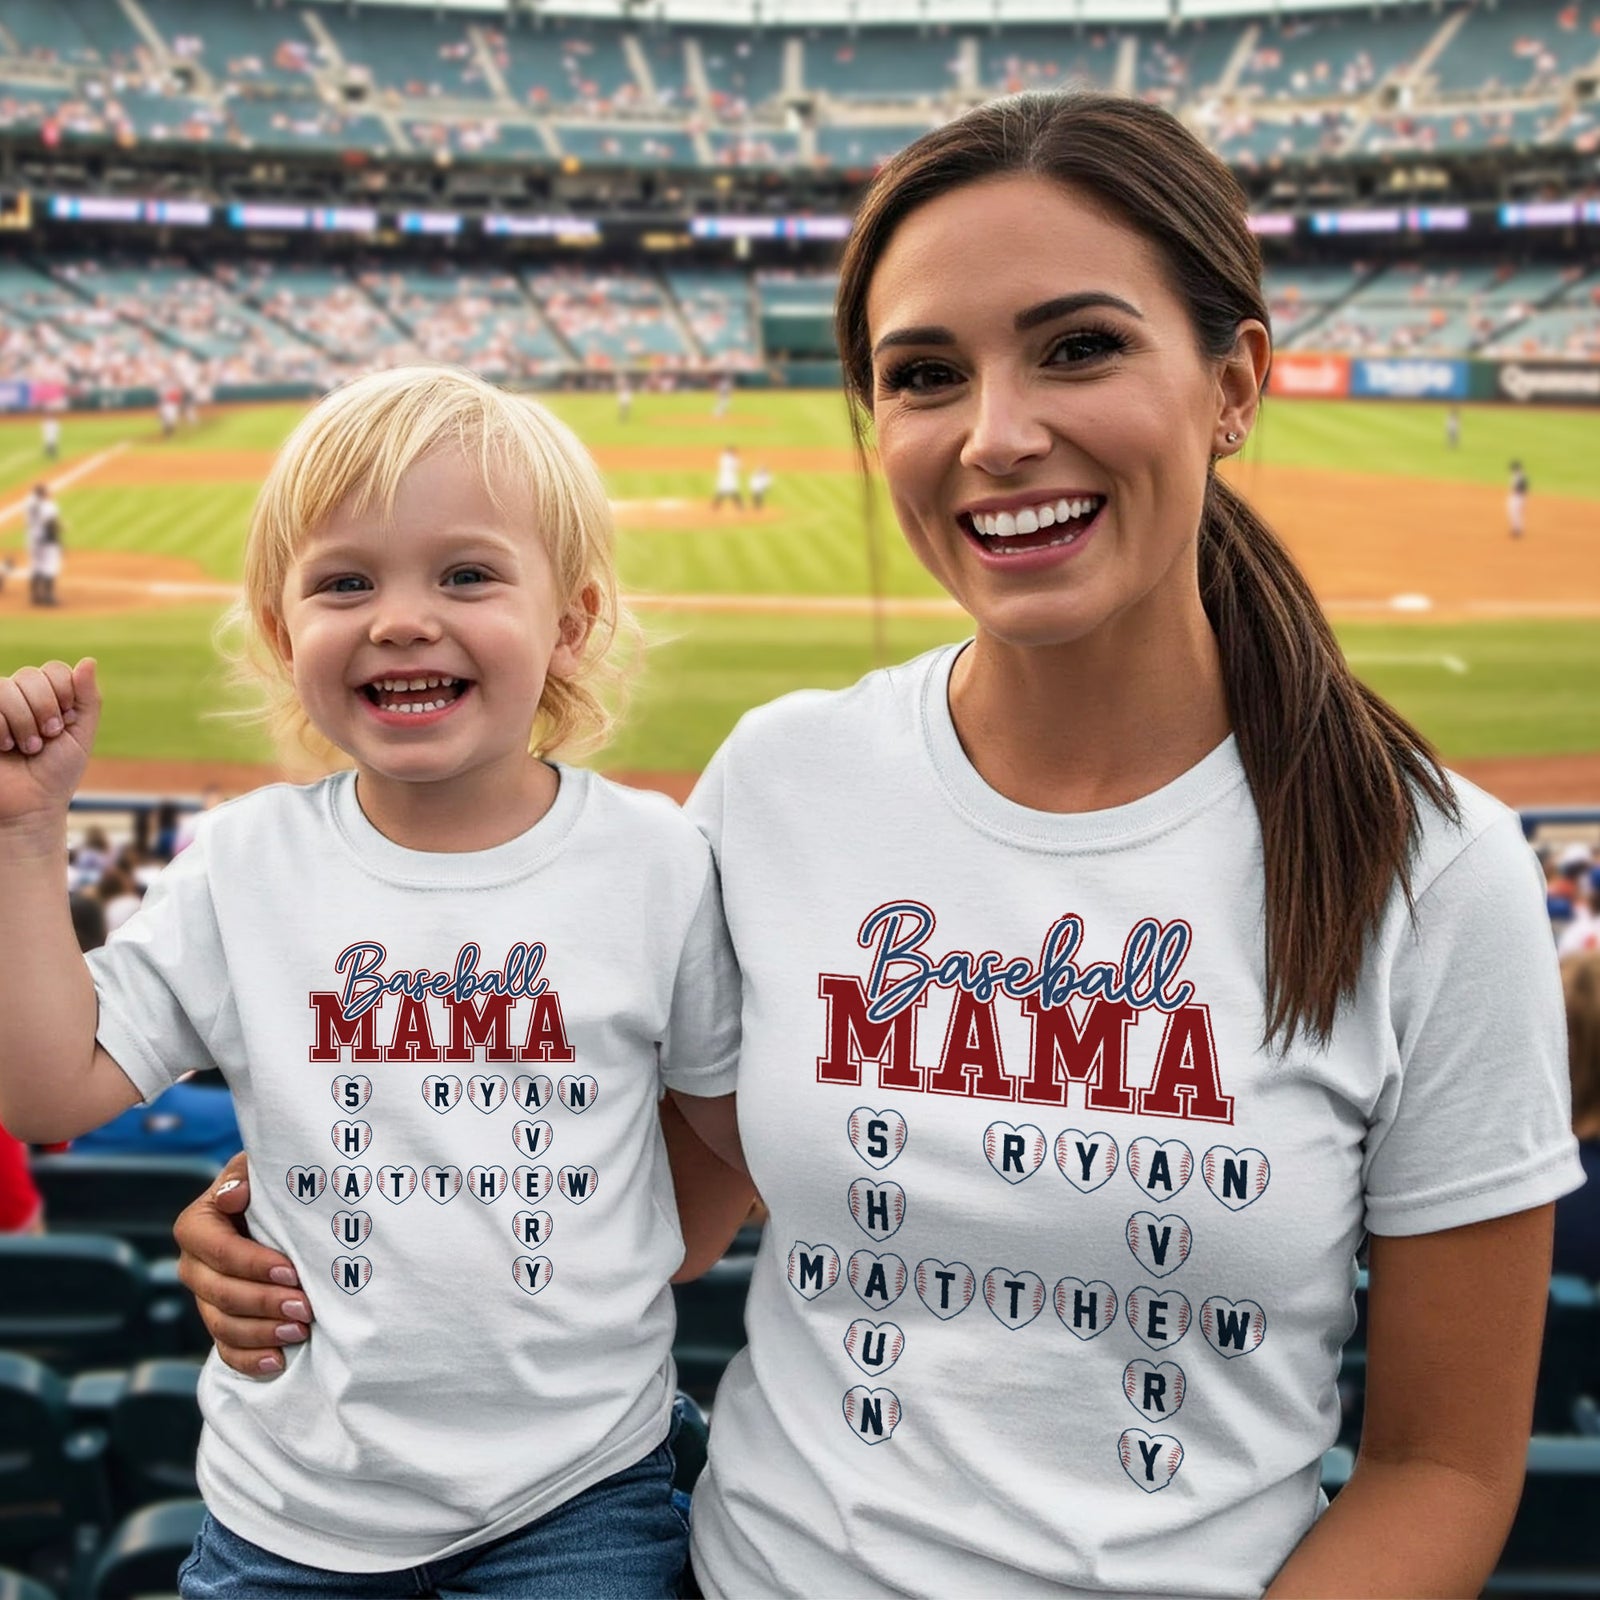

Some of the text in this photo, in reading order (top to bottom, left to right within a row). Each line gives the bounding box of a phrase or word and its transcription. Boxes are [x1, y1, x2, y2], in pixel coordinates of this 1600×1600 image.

[335, 940, 549, 1021] Baseball
[857, 900, 1194, 1023] Baseball
[308, 991, 576, 1063] MAMA
[816, 972, 1235, 1125] MAMA
[435, 1082, 585, 1107] RYAN
[298, 1173, 589, 1198] MATTHEW
[1002, 1133, 1248, 1200] RYAN
[799, 1252, 1252, 1351] MATTHEW
